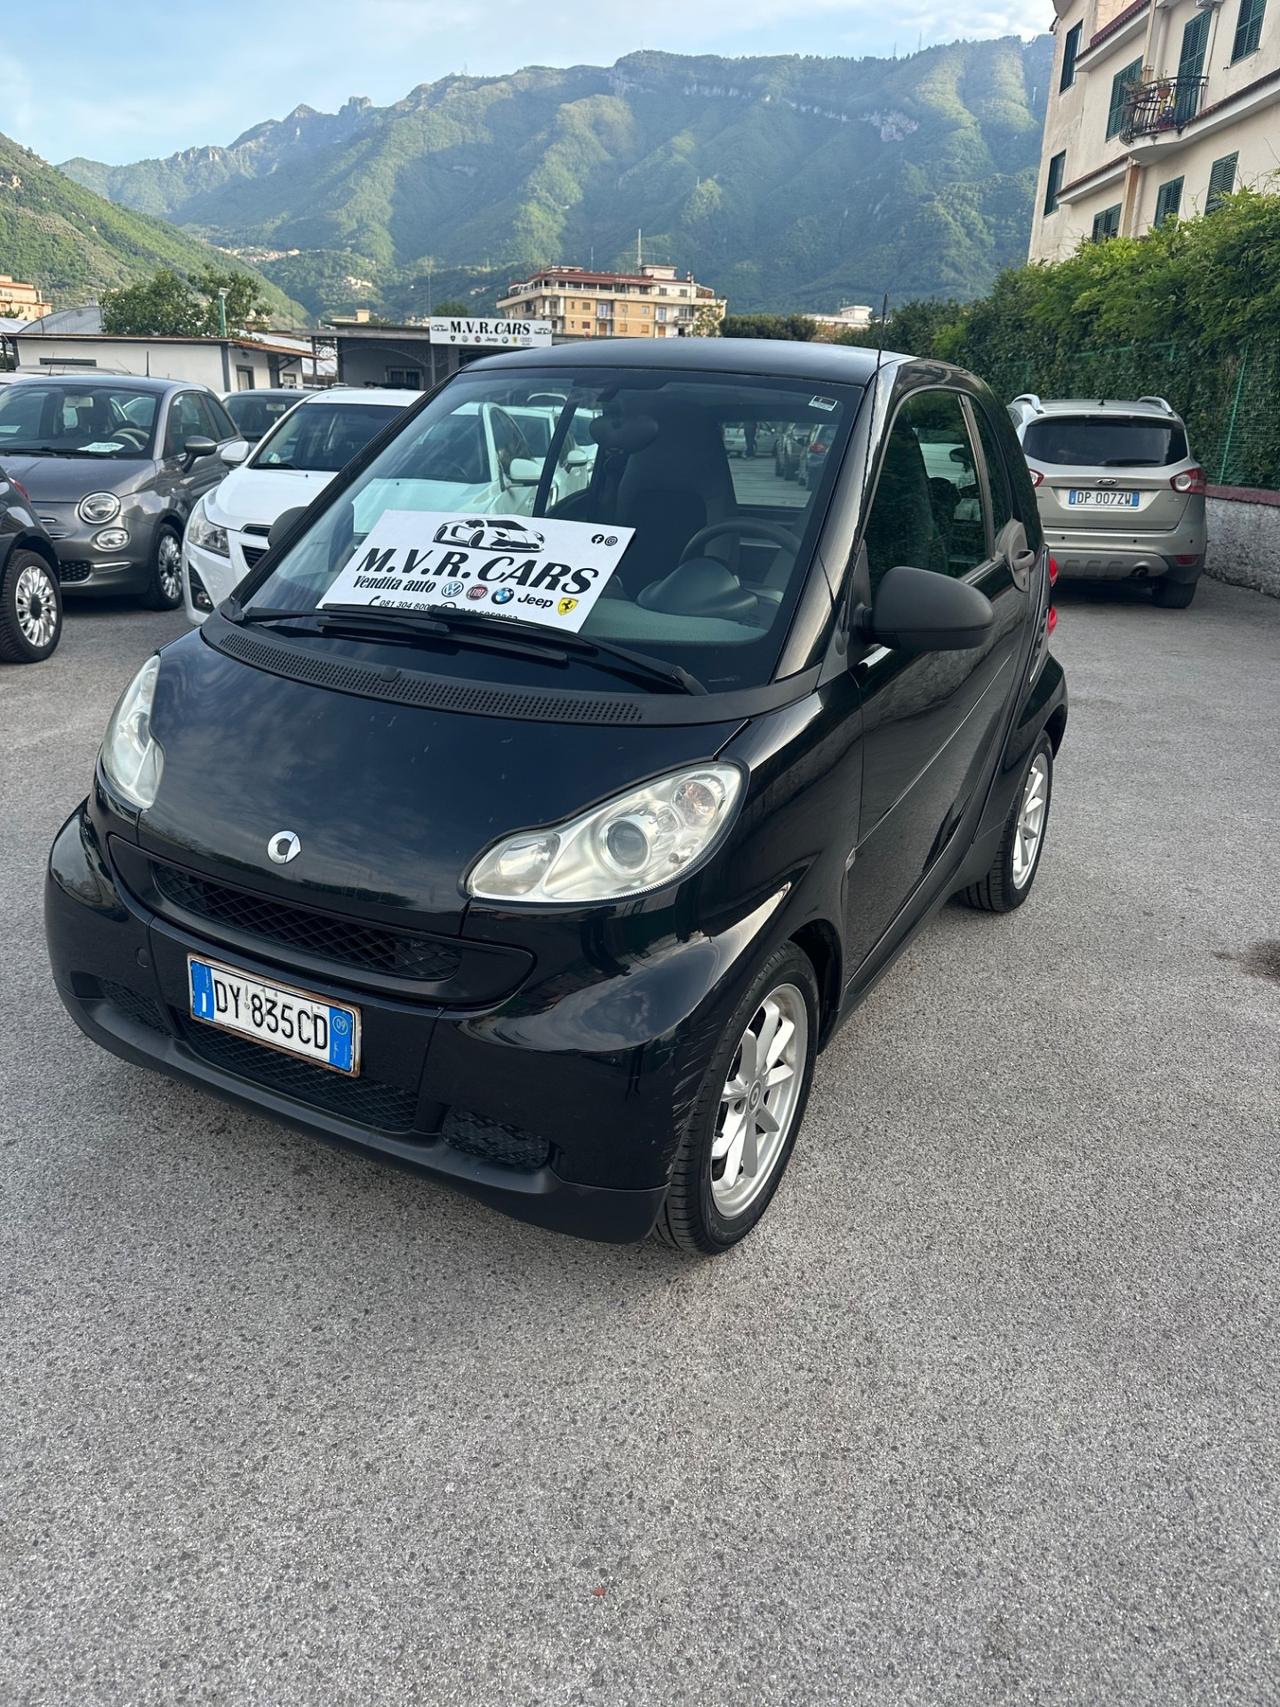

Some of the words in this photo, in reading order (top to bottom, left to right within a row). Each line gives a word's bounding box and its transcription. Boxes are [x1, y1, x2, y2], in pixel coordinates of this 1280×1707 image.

[1077, 491, 1091, 503] DP
[1096, 492, 1131, 505] 007ZW
[353, 575, 403, 591] Vendita
[403, 578, 437, 593] auto
[397, 601, 413, 609] 304
[517, 593, 553, 609] Jeep
[213, 979, 241, 1019] DY
[251, 994, 328, 1049] 835CD
